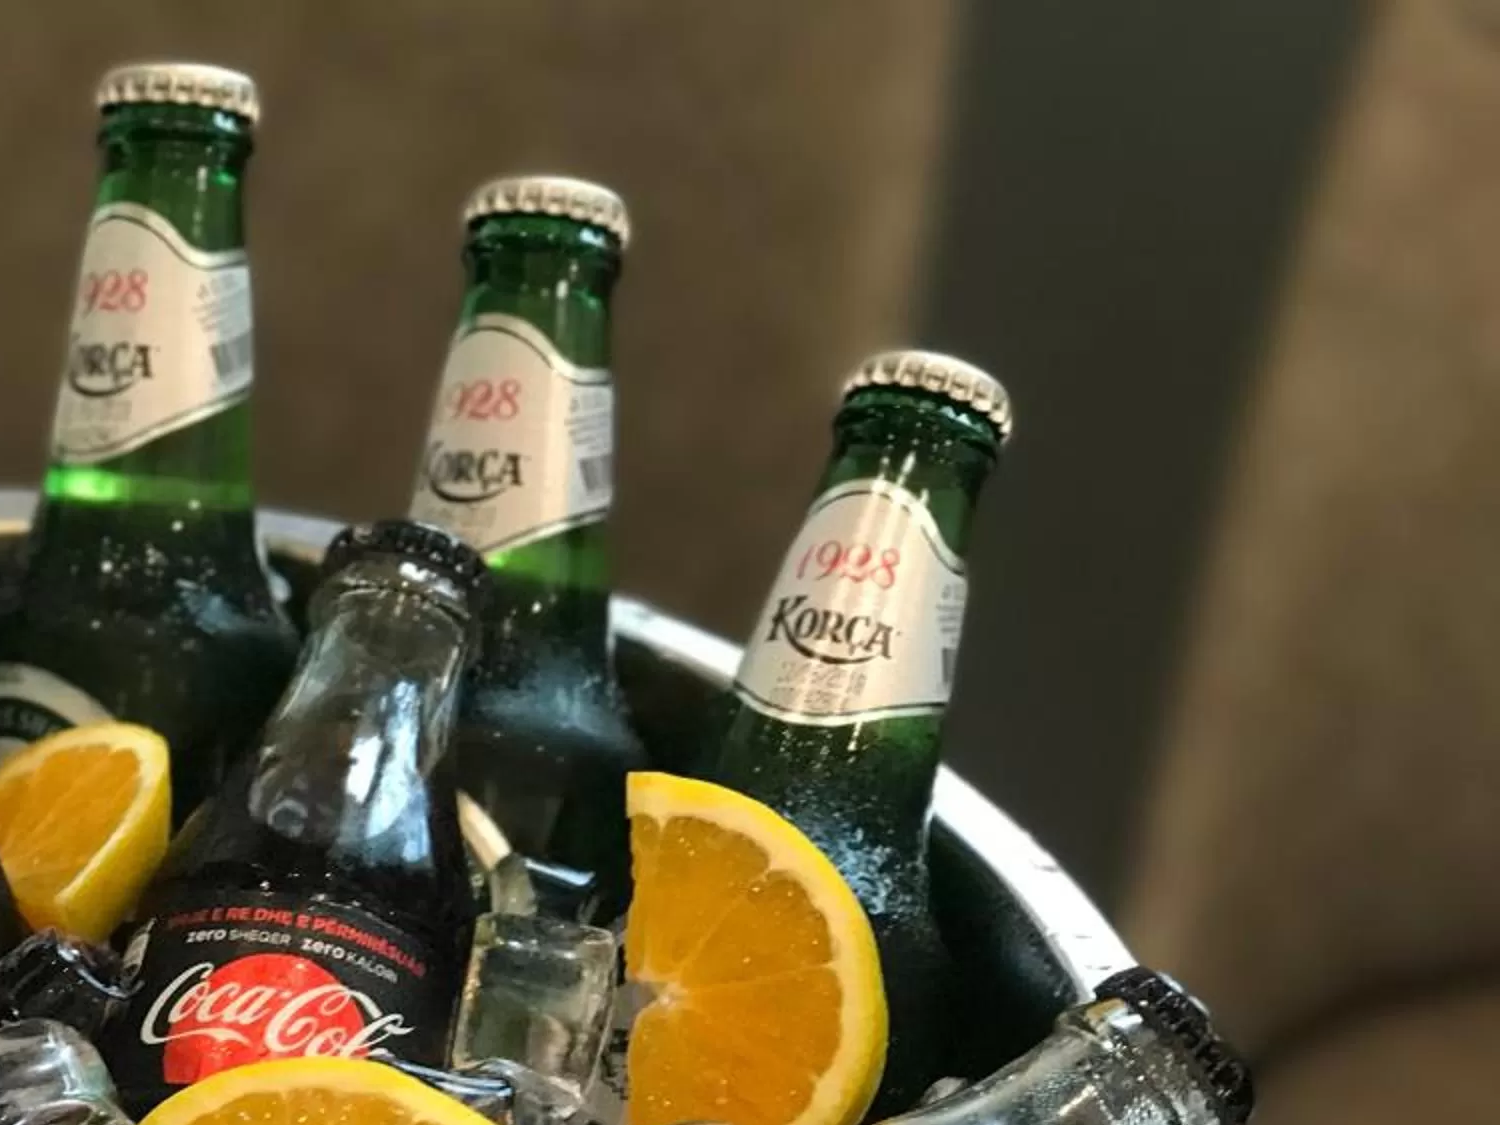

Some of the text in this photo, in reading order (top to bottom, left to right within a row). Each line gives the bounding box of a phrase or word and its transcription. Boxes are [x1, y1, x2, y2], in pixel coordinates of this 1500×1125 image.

[796, 540, 900, 589] 1928
[767, 595, 894, 662] KORÇA
[225, 907, 251, 921] RE
[186, 928, 399, 984] zero SHEQER zero KALORI
